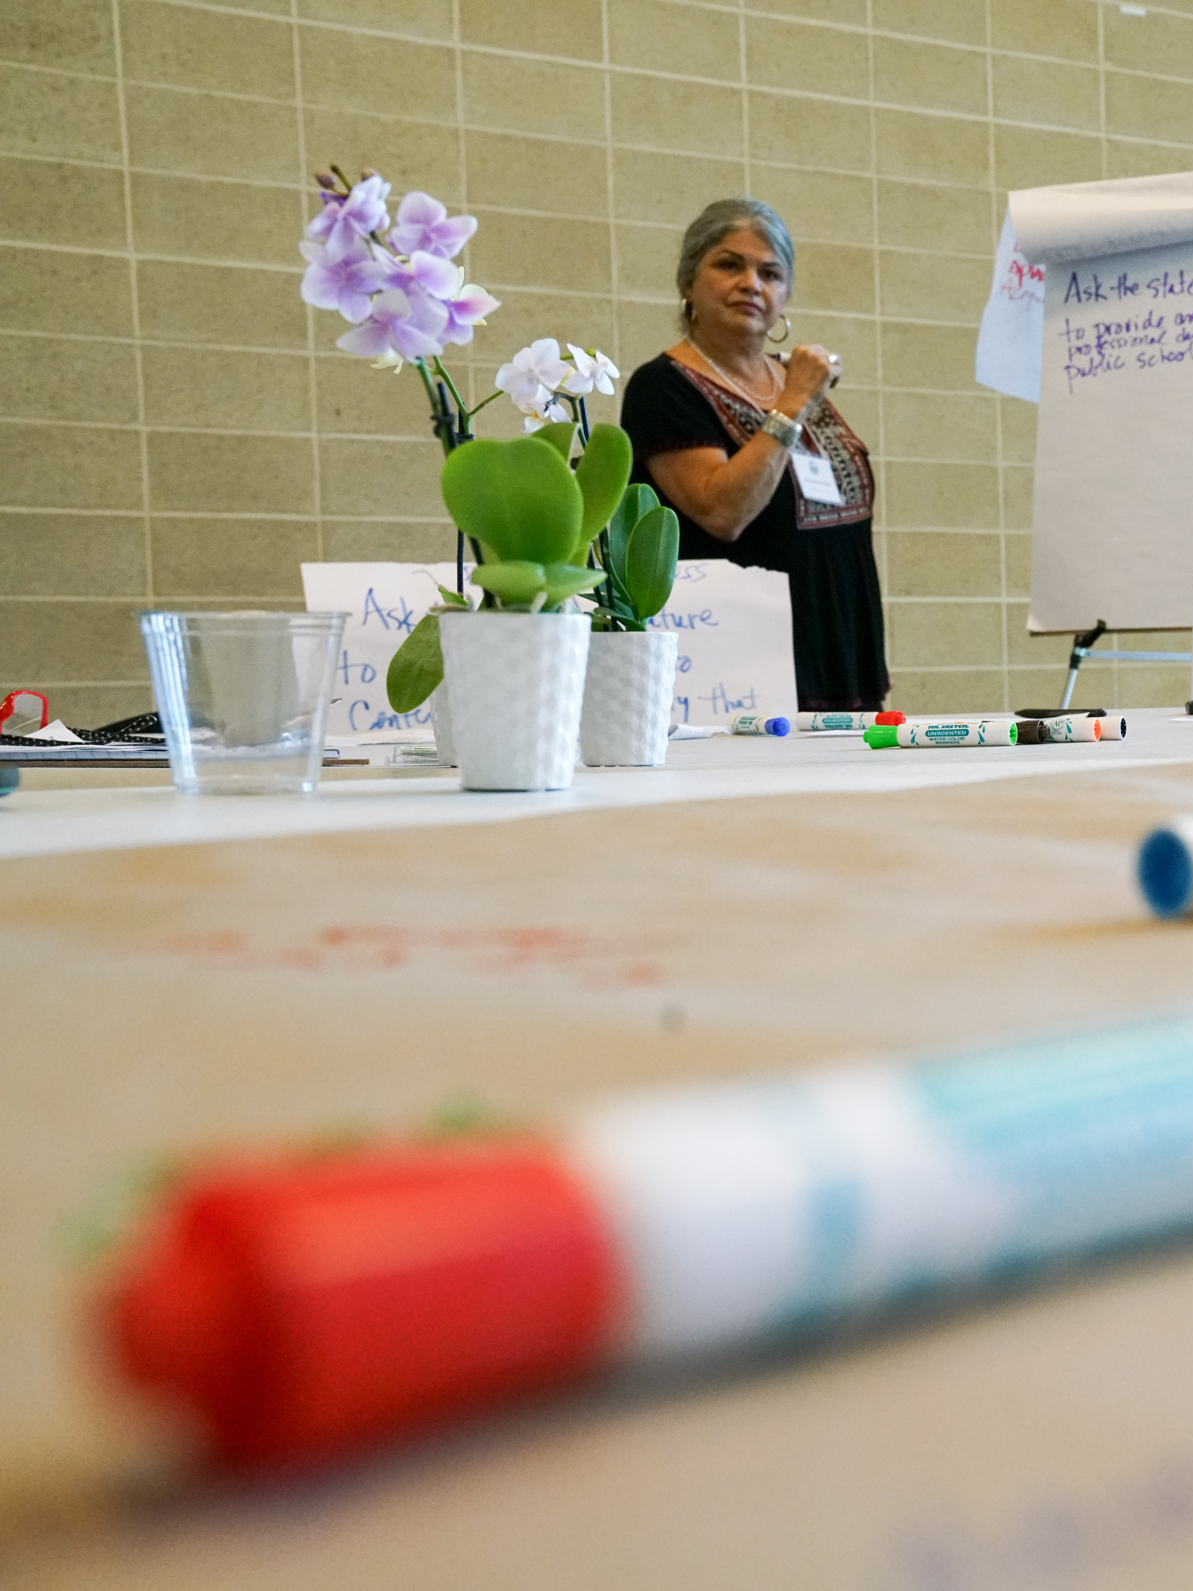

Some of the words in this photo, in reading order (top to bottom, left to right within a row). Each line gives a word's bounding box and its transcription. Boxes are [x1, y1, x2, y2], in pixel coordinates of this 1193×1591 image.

[1063, 270, 1109, 305] Ask
[1109, 272, 1141, 301] the
[1057, 317, 1086, 344] to
[1092, 309, 1166, 342] provide
[1067, 329, 1168, 364] professional
[1062, 353, 1127, 396] public
[337, 650, 377, 685] to
[697, 682, 762, 715] that
